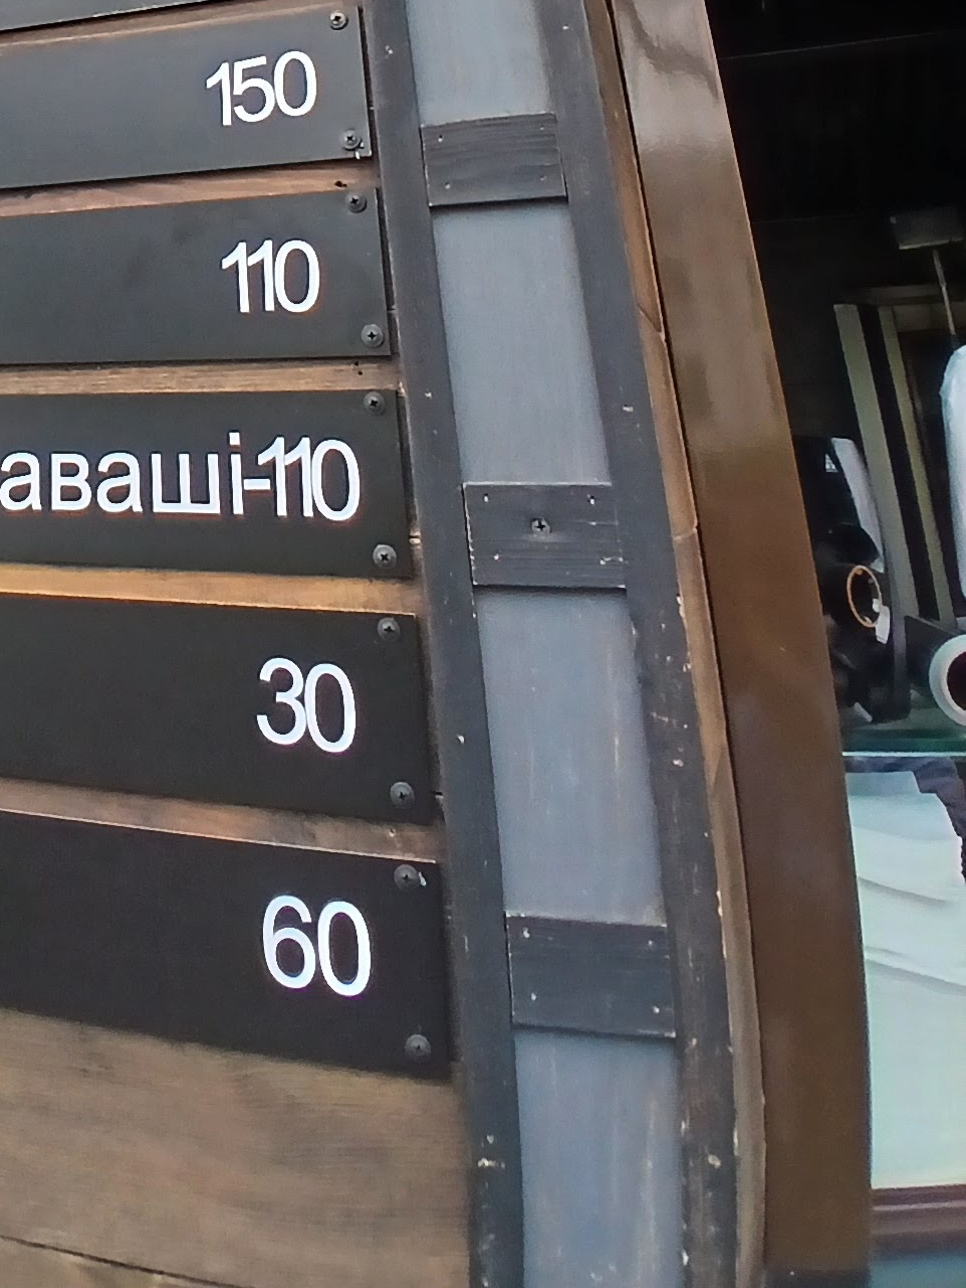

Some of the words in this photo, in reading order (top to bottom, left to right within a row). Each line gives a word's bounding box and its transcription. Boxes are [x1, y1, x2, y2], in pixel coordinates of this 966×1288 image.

[206, 50, 318, 127] 150
[222, 240, 321, 315] 110
[256, 657, 357, 755] 30
[263, 895, 373, 997] 60
